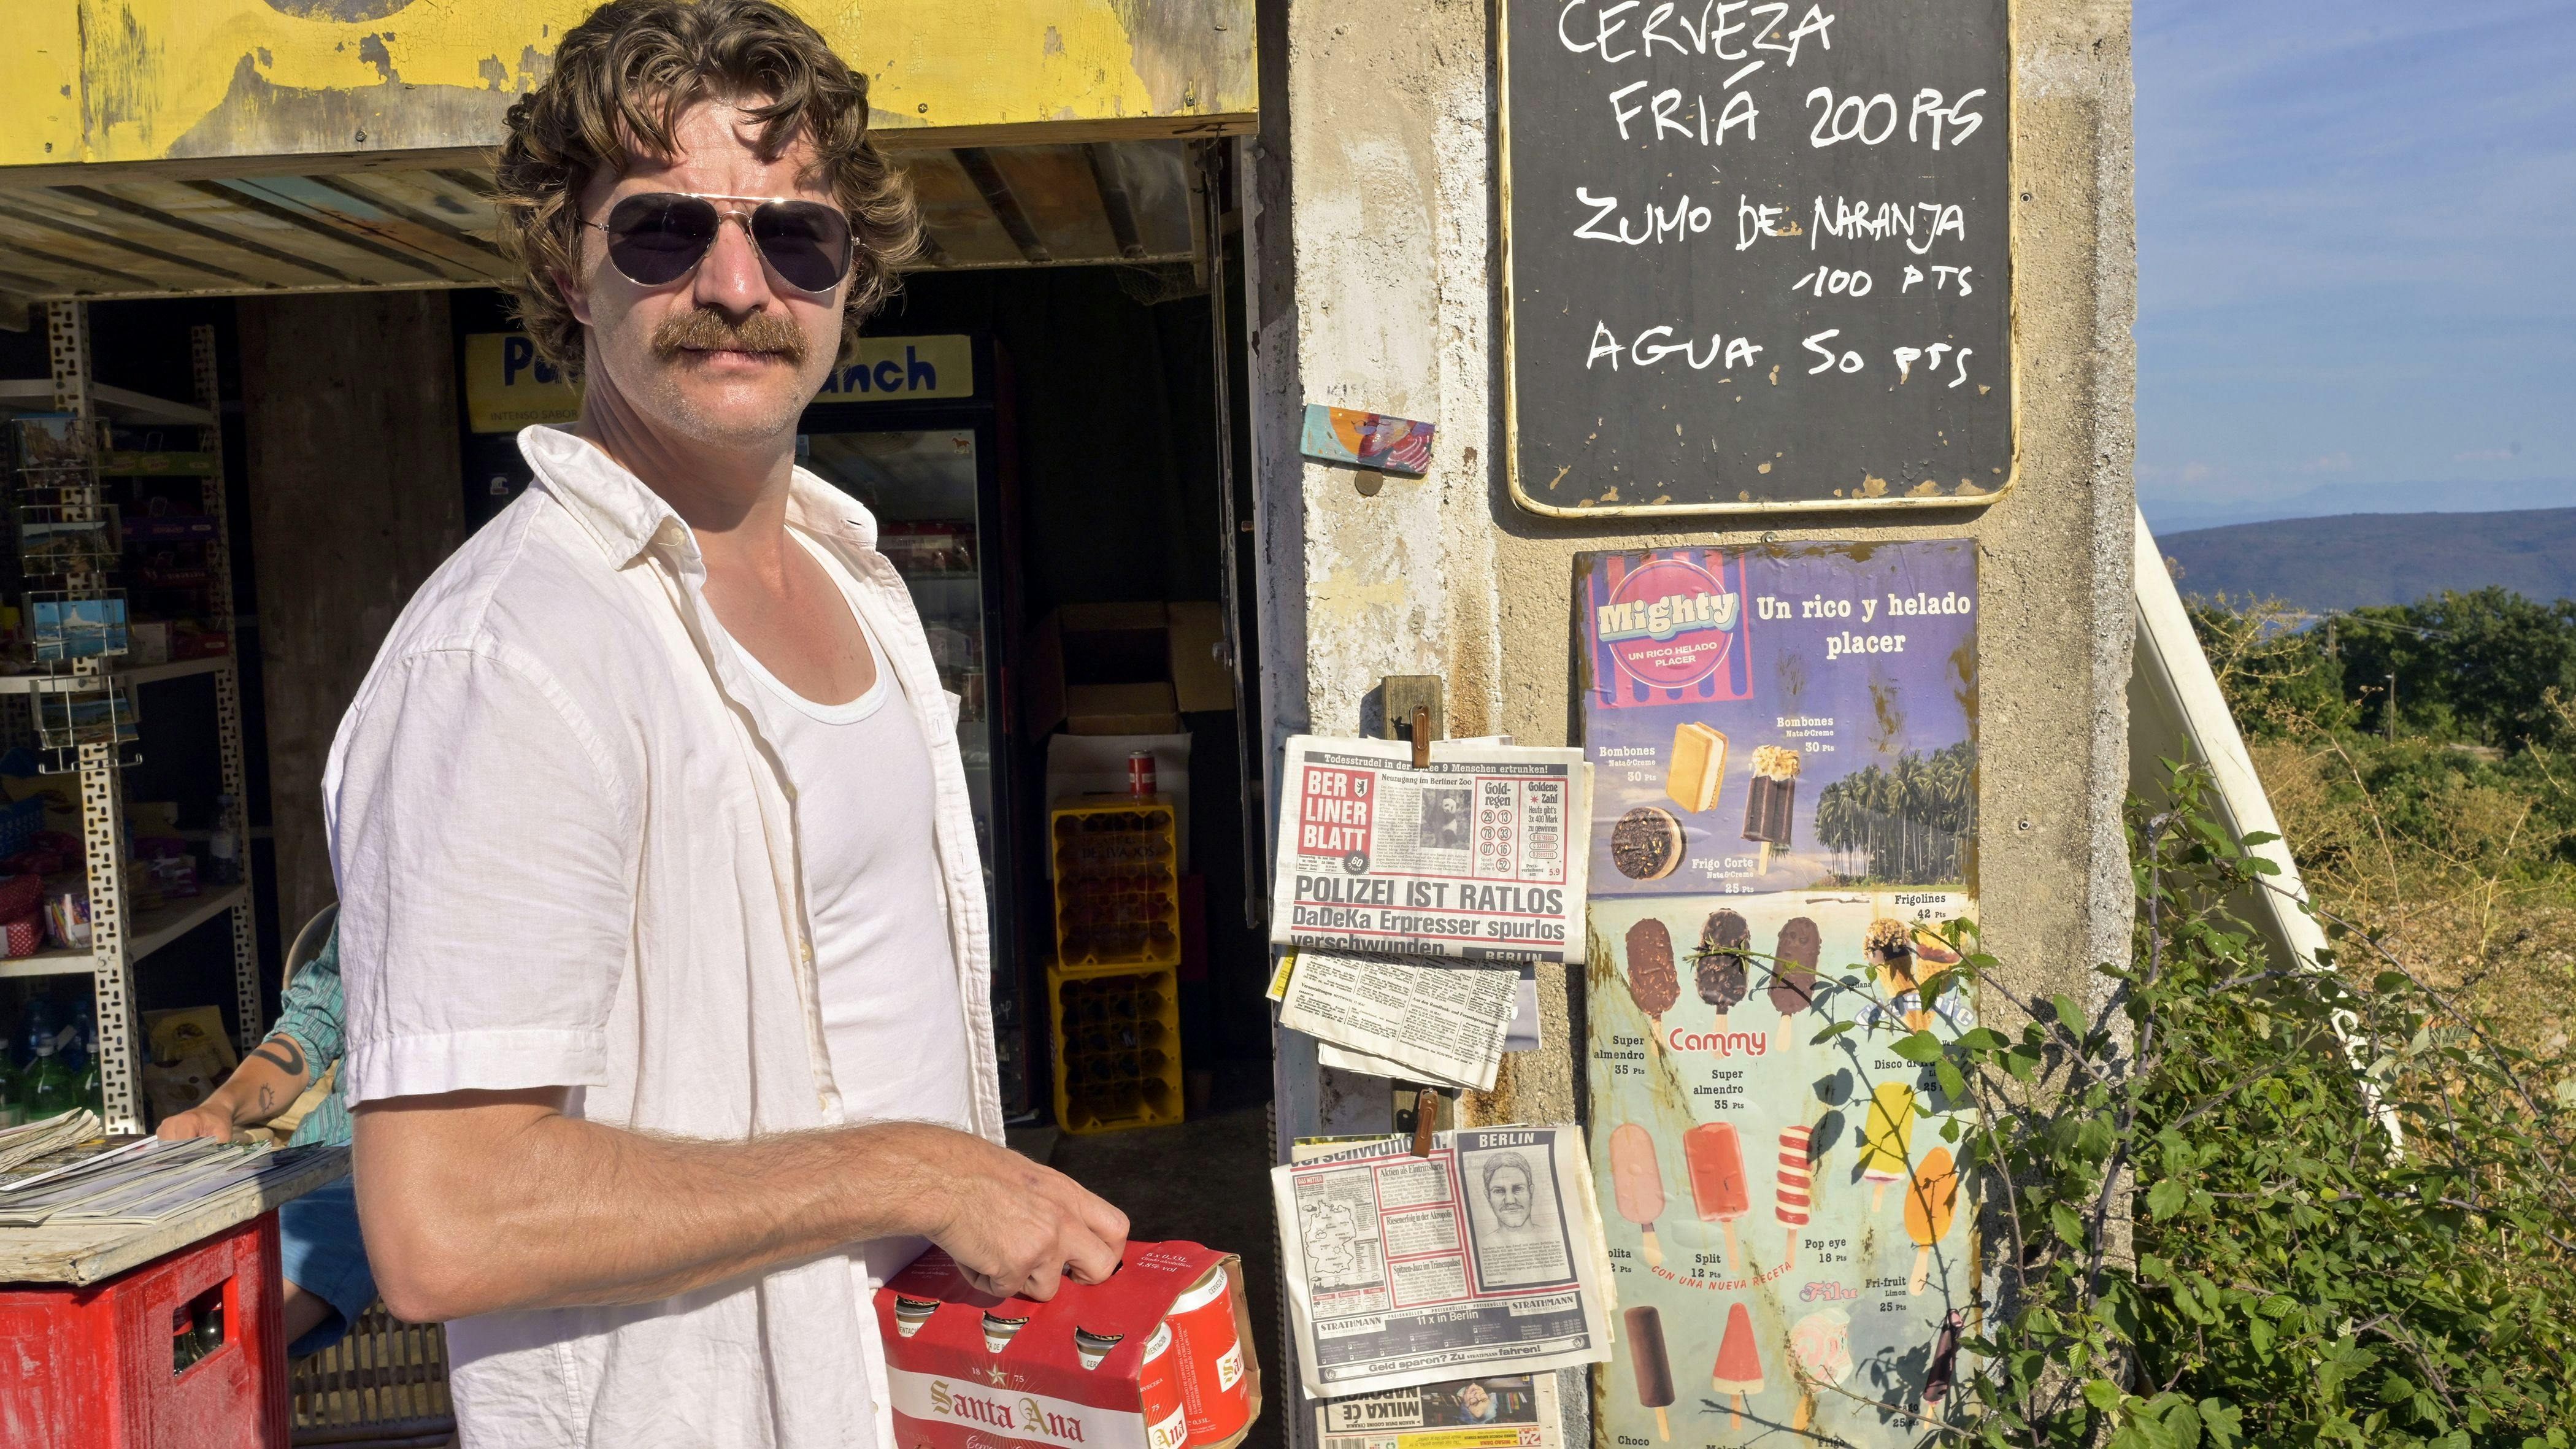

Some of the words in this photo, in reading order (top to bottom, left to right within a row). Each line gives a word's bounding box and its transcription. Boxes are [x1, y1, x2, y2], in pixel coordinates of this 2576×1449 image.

[1559, 0, 1835, 66] CERVEZA
[1807, 88, 1896, 148] 200
[1909, 88, 1986, 150] PTS
[1574, 187, 1710, 245] ZUMO
[1736, 194, 1783, 251] DE
[1812, 196, 1965, 253] NARANJA
[1902, 265, 1972, 296] PTS
[1586, 320, 1763, 371] AGUA
[1893, 343, 1972, 388] PTS
[491, 411, 539, 421] INTENSO
[542, 410, 579, 419] SABOR
[1757, 597, 1791, 620] Un
[1802, 595, 1851, 618] rico
[1862, 599, 1877, 622] y
[1888, 593, 1970, 617] helado
[1598, 591, 1737, 639] Mighty
[1628, 652, 1644, 661] UN
[1647, 648, 1672, 659] RICO
[1674, 641, 1717, 656] HELADO
[1827, 631, 1905, 659] placer
[1655, 654, 1696, 667] PLACER
[1777, 717, 1833, 728] Bombones
[1786, 729, 1834, 737] Nata&Creme
[1599, 746, 1655, 758] Bombones
[1805, 742, 1820, 753] 30
[1325, 754, 1381, 767] Todesstrudel
[1452, 764, 1499, 774] Menschen
[1500, 766, 1548, 774] ertrunken!
[1382, 774, 1417, 784] Neuzugang
[1628, 771, 1642, 782] 30
[1307, 771, 1346, 797] BER
[1485, 782, 1510, 794] Gold-
[1529, 782, 1558, 792] Goldene
[1485, 796, 1510, 809] regen
[1542, 794, 1557, 804] Zahl
[1305, 798, 1366, 825] LINER
[1544, 806, 1556, 815] gibt's
[1484, 812, 1492, 822] 29
[1501, 812, 1508, 822] 13
[1484, 829, 1491, 839] 78
[1501, 829, 1508, 839] 33
[1535, 824, 1557, 834] gewinnen
[1304, 824, 1366, 850] BLATT
[1483, 844, 1491, 853] 07
[1500, 844, 1507, 854] 16
[1351, 856, 1363, 867] 60
[1499, 860, 1507, 870] 52
[1692, 858, 1720, 871] Frigo
[1725, 857, 1753, 868] Corte
[1725, 883, 1739, 893] 25
[1295, 875, 1394, 906] POLIZEI
[1407, 880, 1450, 909] IST
[1459, 884, 1563, 915] RATLOS
[1895, 893, 1945, 906] Frigolines
[1917, 909, 1931, 920] 42
[1293, 905, 1371, 931] DaDeKa
[1380, 911, 1480, 939] Erpresser
[1487, 919, 1564, 942] spurlos
[1613, 1036, 1644, 1048] Super
[1669, 1028, 1766, 1056] Cammy
[1594, 1049, 1645, 1061] almendro
[1615, 1064, 1629, 1075] 35
[1875, 1060, 1902, 1070] Disco
[1712, 1069, 1743, 1082] Super
[1693, 1084, 1744, 1095] almendro
[1924, 1082, 1936, 1091] 25
[1714, 1100, 1728, 1109] 35
[1480, 1132, 1534, 1148] BERLIN
[1380, 1167, 1399, 1177] Aktien
[1409, 1163, 1444, 1173] Eintrittskarte
[1386, 1216, 1415, 1225] Riesenerfolg
[1430, 1210, 1452, 1220] Akropolis
[1805, 1239, 1824, 1250] Pop
[1828, 1239, 1846, 1250] eye
[1609, 1248, 1631, 1258] olita
[1819, 1253, 1832, 1263] 18
[1696, 1254, 1721, 1265] Split
[1393, 1263, 1422, 1277] Spitzen-Jazz
[1431, 1258, 1461, 1269] Tränenpalast
[1691, 1268, 1704, 1278] 12
[1651, 1266, 1675, 1281] CON
[1679, 1276, 1702, 1289] UNA
[1709, 1280, 1747, 1290] NUEVA
[1753, 1261, 1791, 1286] RECETA
[1209, 1278, 1222, 1295] CERVEZA
[1865, 1277, 1906, 1288] Fri-fruit
[1513, 1296, 1573, 1310] STRATHMANN
[1880, 1302, 1892, 1312] 25
[1417, 1316, 1426, 1325] 11
[1437, 1313, 1447, 1323] in
[1449, 1310, 1478, 1321] Berlin
[1321, 1317, 1381, 1331] STRATHMANN
[1369, 1361, 1396, 1372] Geld
[1399, 1355, 1447, 1369] sparen?
[1499, 1345, 1540, 1356] fahren!
[930, 1380, 1015, 1429] Santa
[1018, 1397, 1085, 1443] Ana
[1152, 1404, 1159, 1412] 75
[1343, 1404, 1361, 1423] ĆE
[1366, 1401, 1419, 1418] MILKA
[1893, 1418, 1905, 1428] 25
[1152, 1420, 1185, 1448] Ana
[1618, 1436, 1650, 1446] Choco
